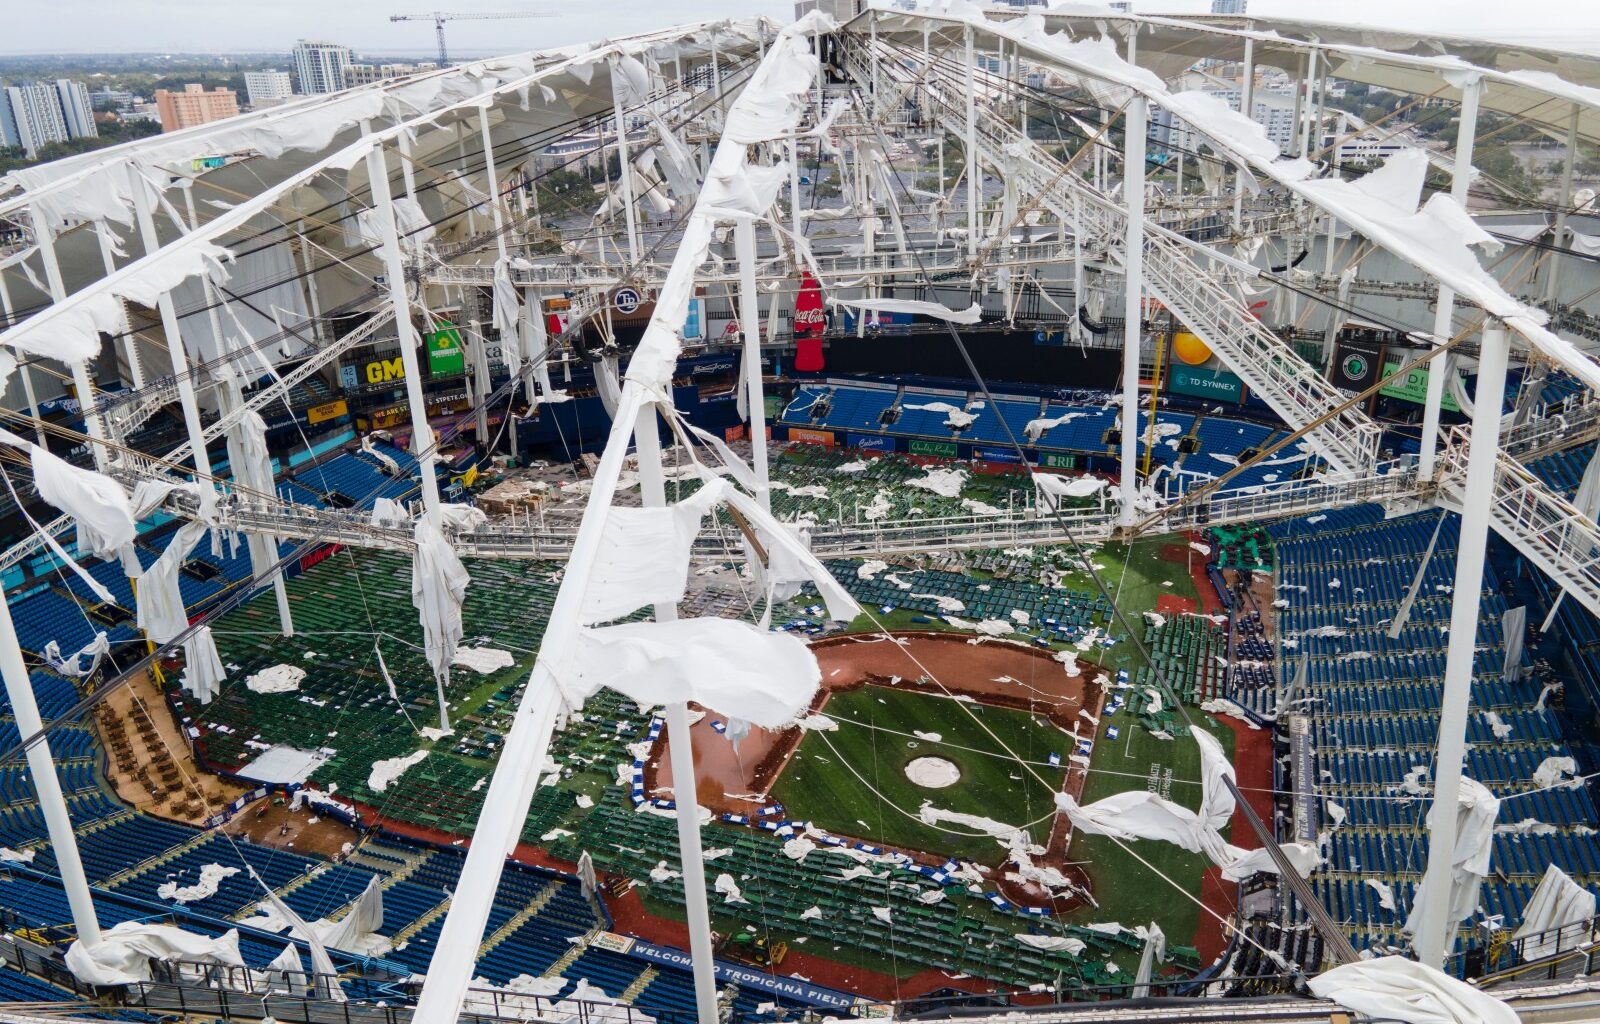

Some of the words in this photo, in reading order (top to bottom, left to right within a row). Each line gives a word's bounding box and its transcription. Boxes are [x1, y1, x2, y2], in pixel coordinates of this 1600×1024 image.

[366, 356, 405, 384] GM
[1190, 377, 1201, 386] TD
[1202, 380, 1236, 392] SYNNEX
[725, 968, 802, 996] TROPICANA
[808, 991, 850, 1007] FIELD
